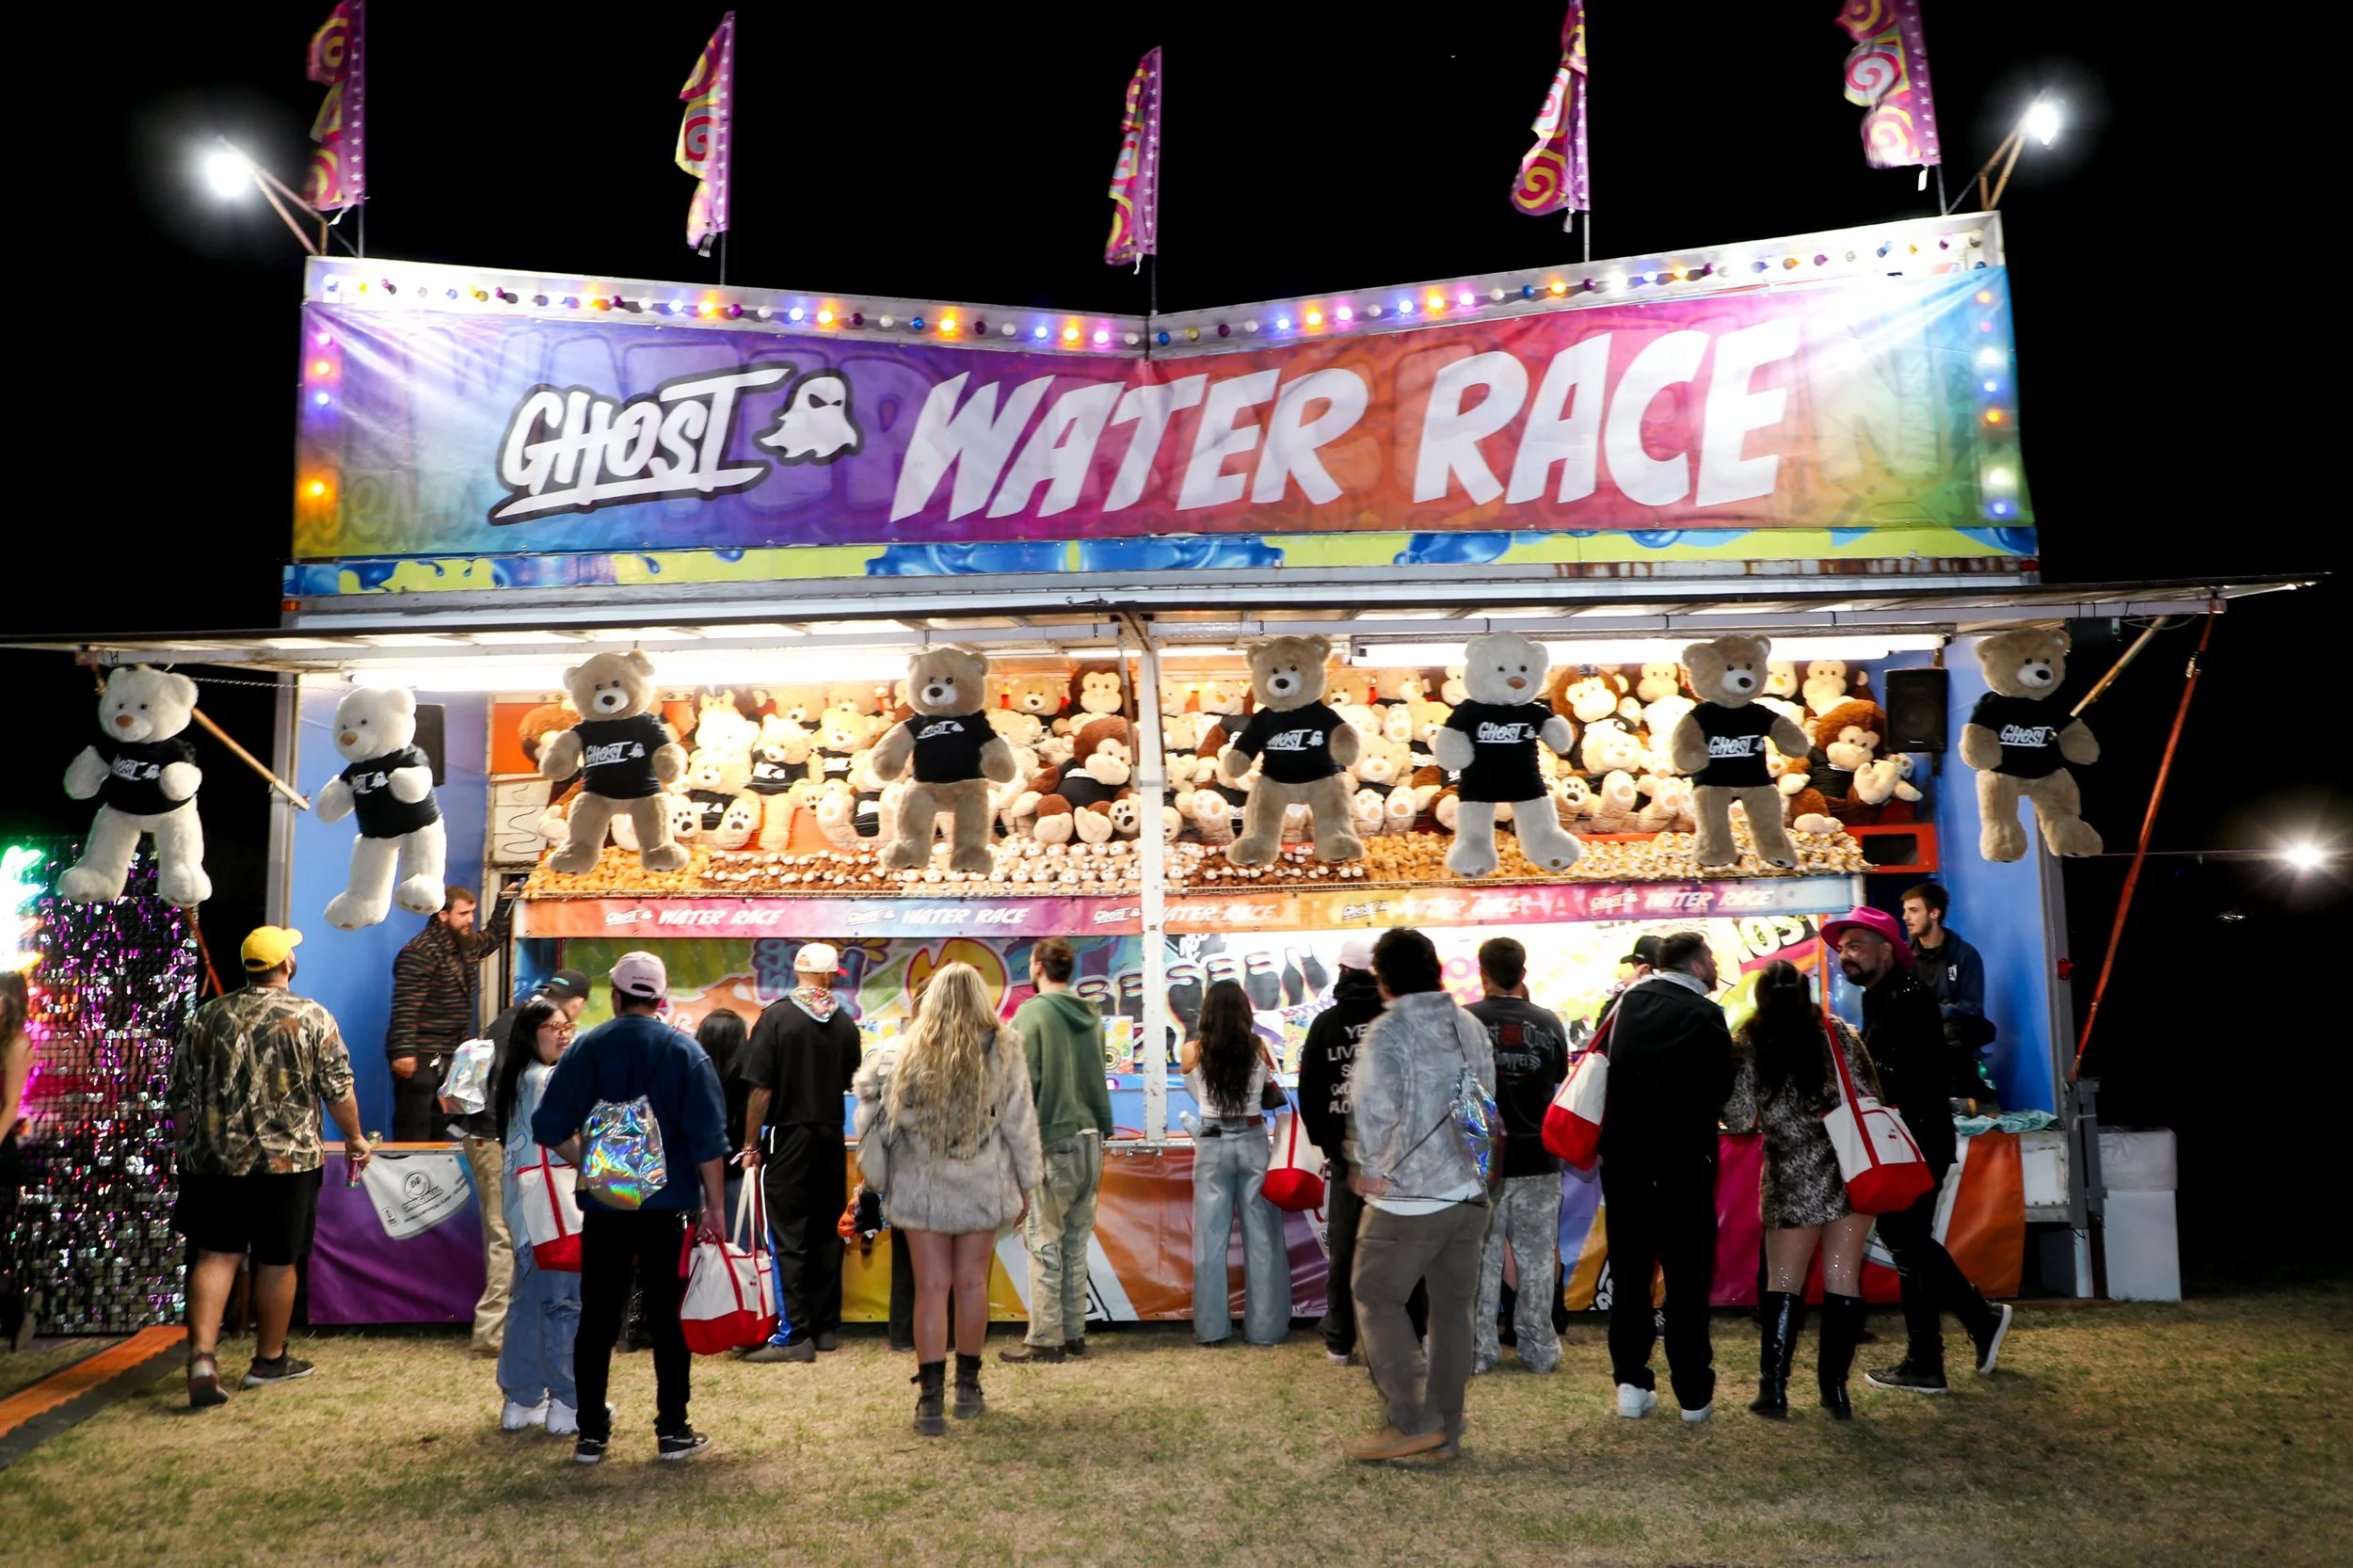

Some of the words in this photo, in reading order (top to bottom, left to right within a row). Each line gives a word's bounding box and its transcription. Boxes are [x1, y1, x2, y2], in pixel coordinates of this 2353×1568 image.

[493, 363, 792, 523] GHOST
[890, 368, 1369, 522] WATER
[1413, 318, 1800, 507] RACE
[1476, 722, 1530, 744] GHOST
[1999, 724, 2052, 747] GHOST
[585, 741, 632, 768] GHOST
[1708, 734, 1759, 757] GHOST
[1645, 891, 1714, 908] WATER
[1719, 889, 1773, 906] RACE
[658, 909, 725, 926] WATER
[730, 909, 785, 926] RACE
[901, 908, 970, 925] WATER
[974, 907, 1030, 924] RACE
